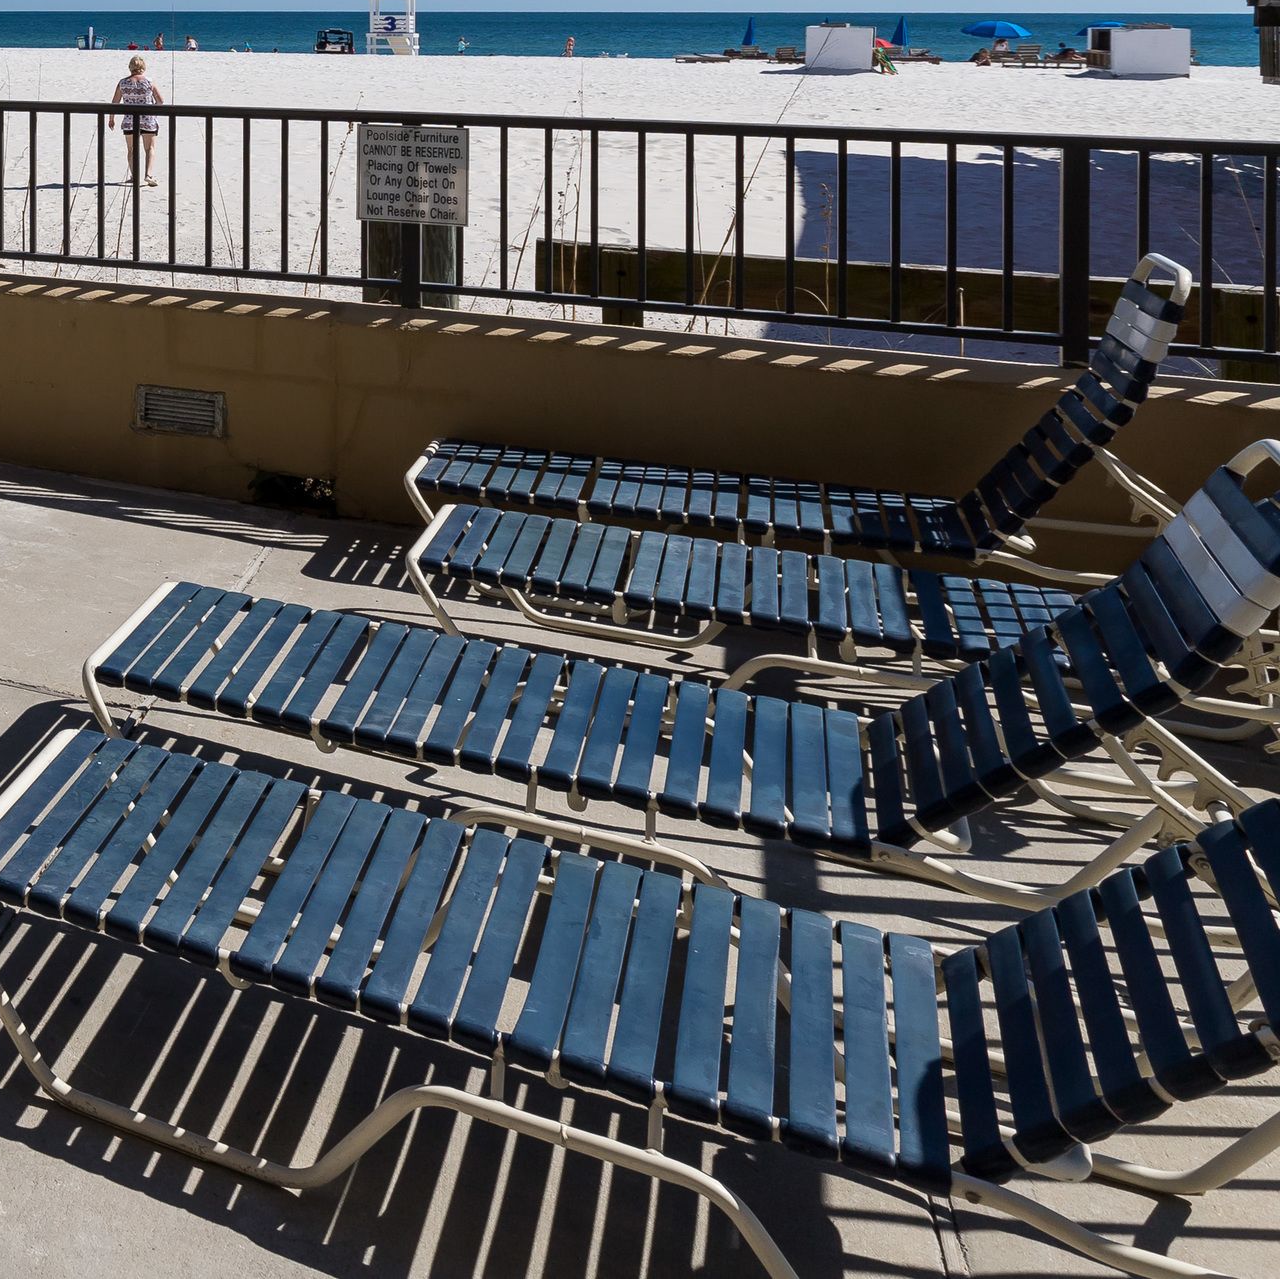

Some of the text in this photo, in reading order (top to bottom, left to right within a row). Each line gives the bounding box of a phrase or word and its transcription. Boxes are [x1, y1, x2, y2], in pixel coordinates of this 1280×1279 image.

[384, 16, 396, 31] 3
[367, 130, 459, 143] Poolside Furniture
[363, 144, 463, 159] CANNOT BE RESERVED.
[368, 160, 457, 174] Placing Of Towels
[370, 175, 455, 190] Or Any Object On
[367, 190, 457, 204] Lounge Chair Does
[367, 205, 457, 220] Not Reserve Chair.
